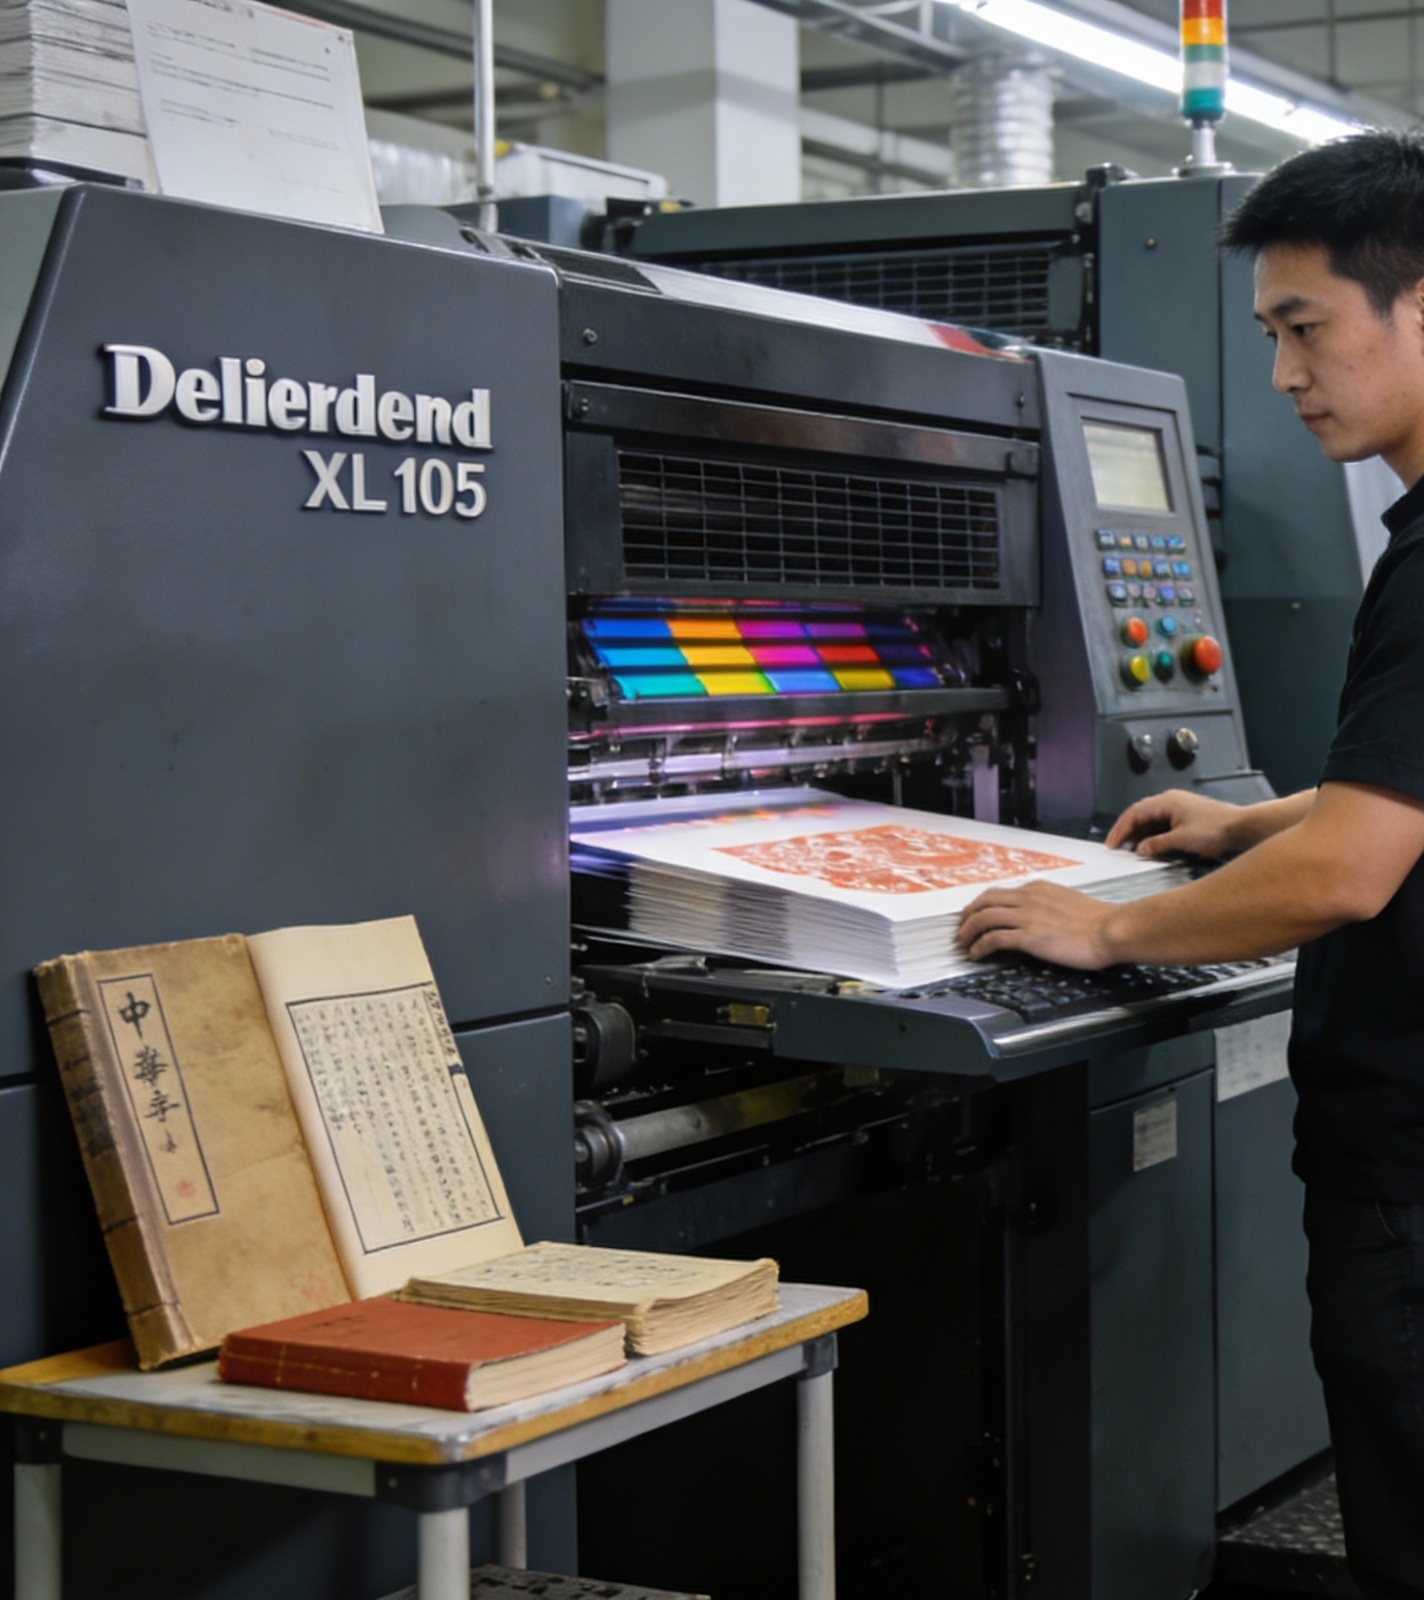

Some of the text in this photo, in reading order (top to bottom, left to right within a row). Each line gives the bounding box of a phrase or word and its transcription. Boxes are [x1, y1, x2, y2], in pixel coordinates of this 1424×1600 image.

[102, 344, 494, 450] Delierdend
[302, 450, 488, 518] XL 105
